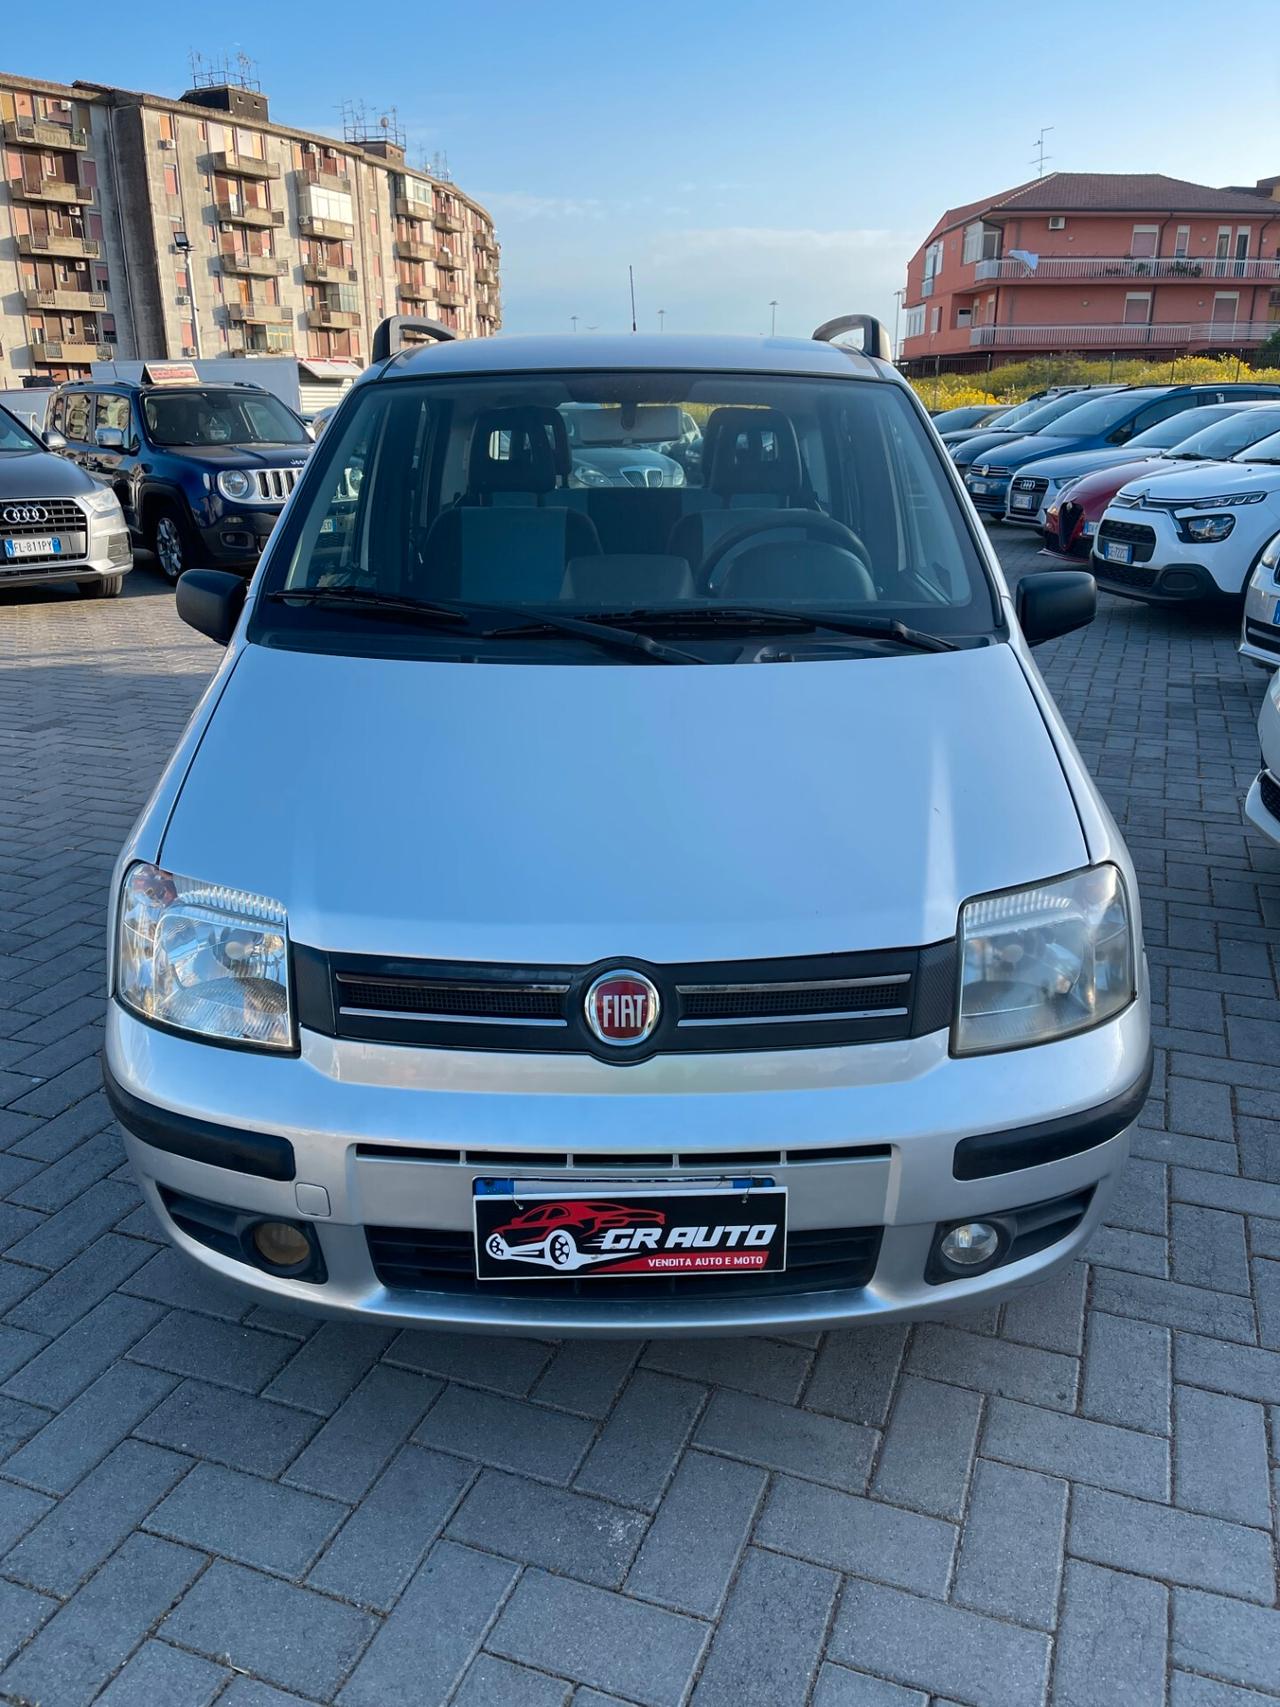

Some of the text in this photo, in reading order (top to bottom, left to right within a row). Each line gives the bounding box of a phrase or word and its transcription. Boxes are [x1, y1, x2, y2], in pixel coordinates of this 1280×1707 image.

[603, 995, 646, 1028] FIAT
[600, 1224, 777, 1250] GR AUTO
[648, 1255, 764, 1267] VENDITA AUTO E MOTO
